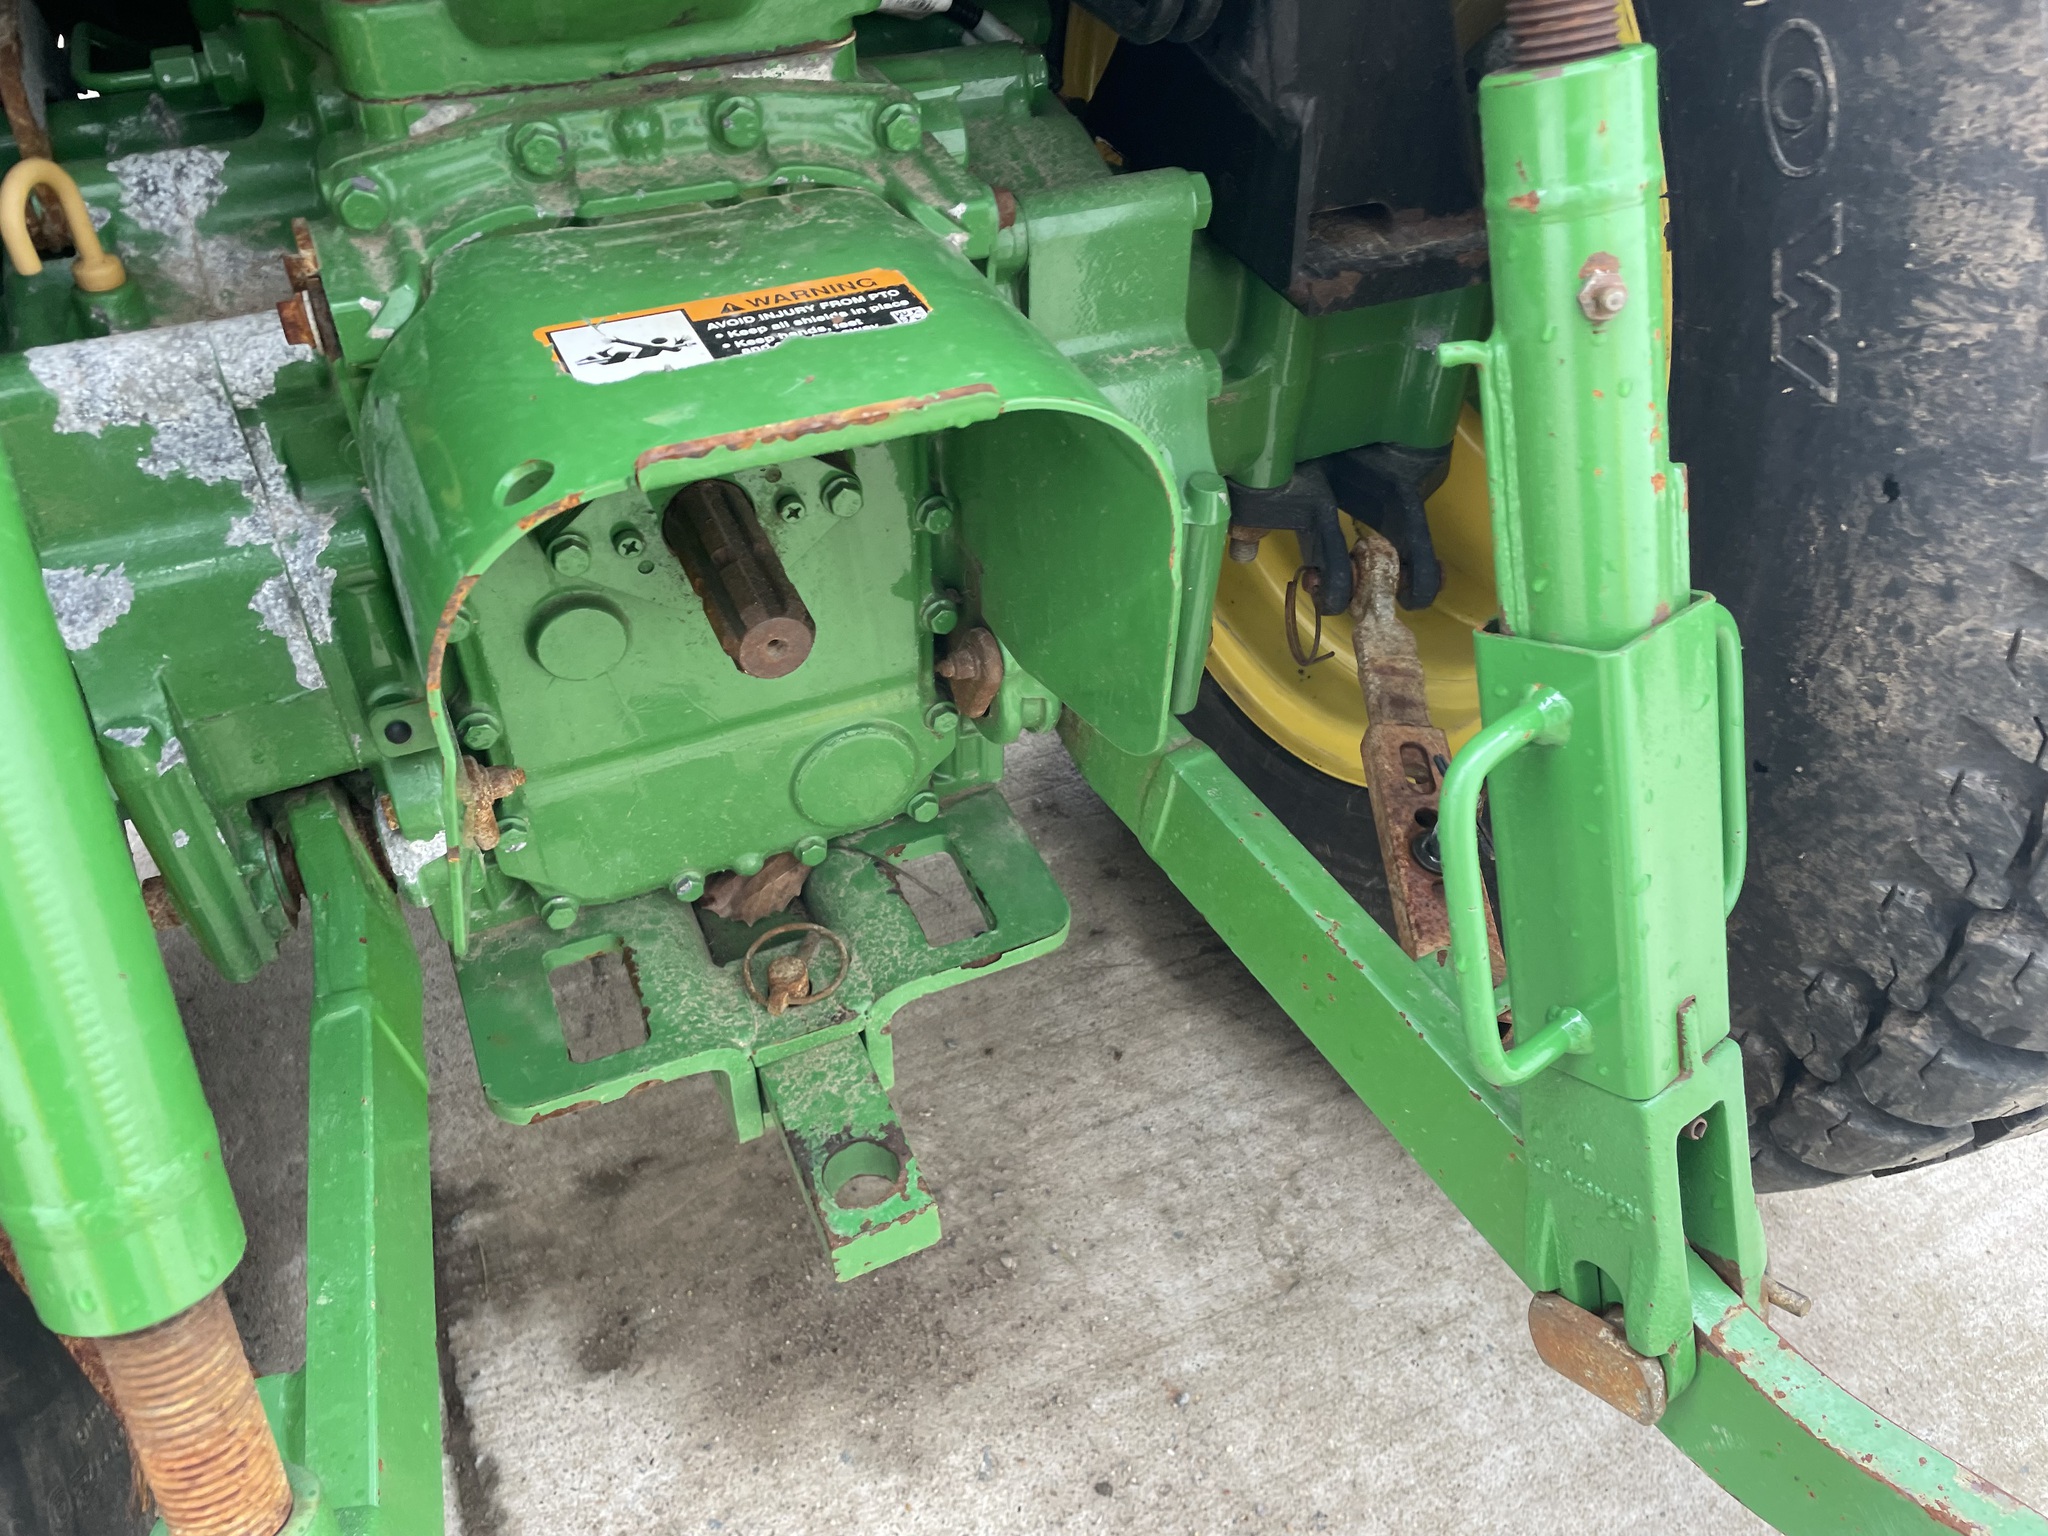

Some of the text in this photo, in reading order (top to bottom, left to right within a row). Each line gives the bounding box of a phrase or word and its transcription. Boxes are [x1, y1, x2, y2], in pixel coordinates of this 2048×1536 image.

[746, 278, 877, 307] WARNING
[707, 289, 900, 331] AVOID INJURY FROM PTO
[727, 299, 910, 339] Keep all shields in place
[734, 335, 775, 348] Keep
